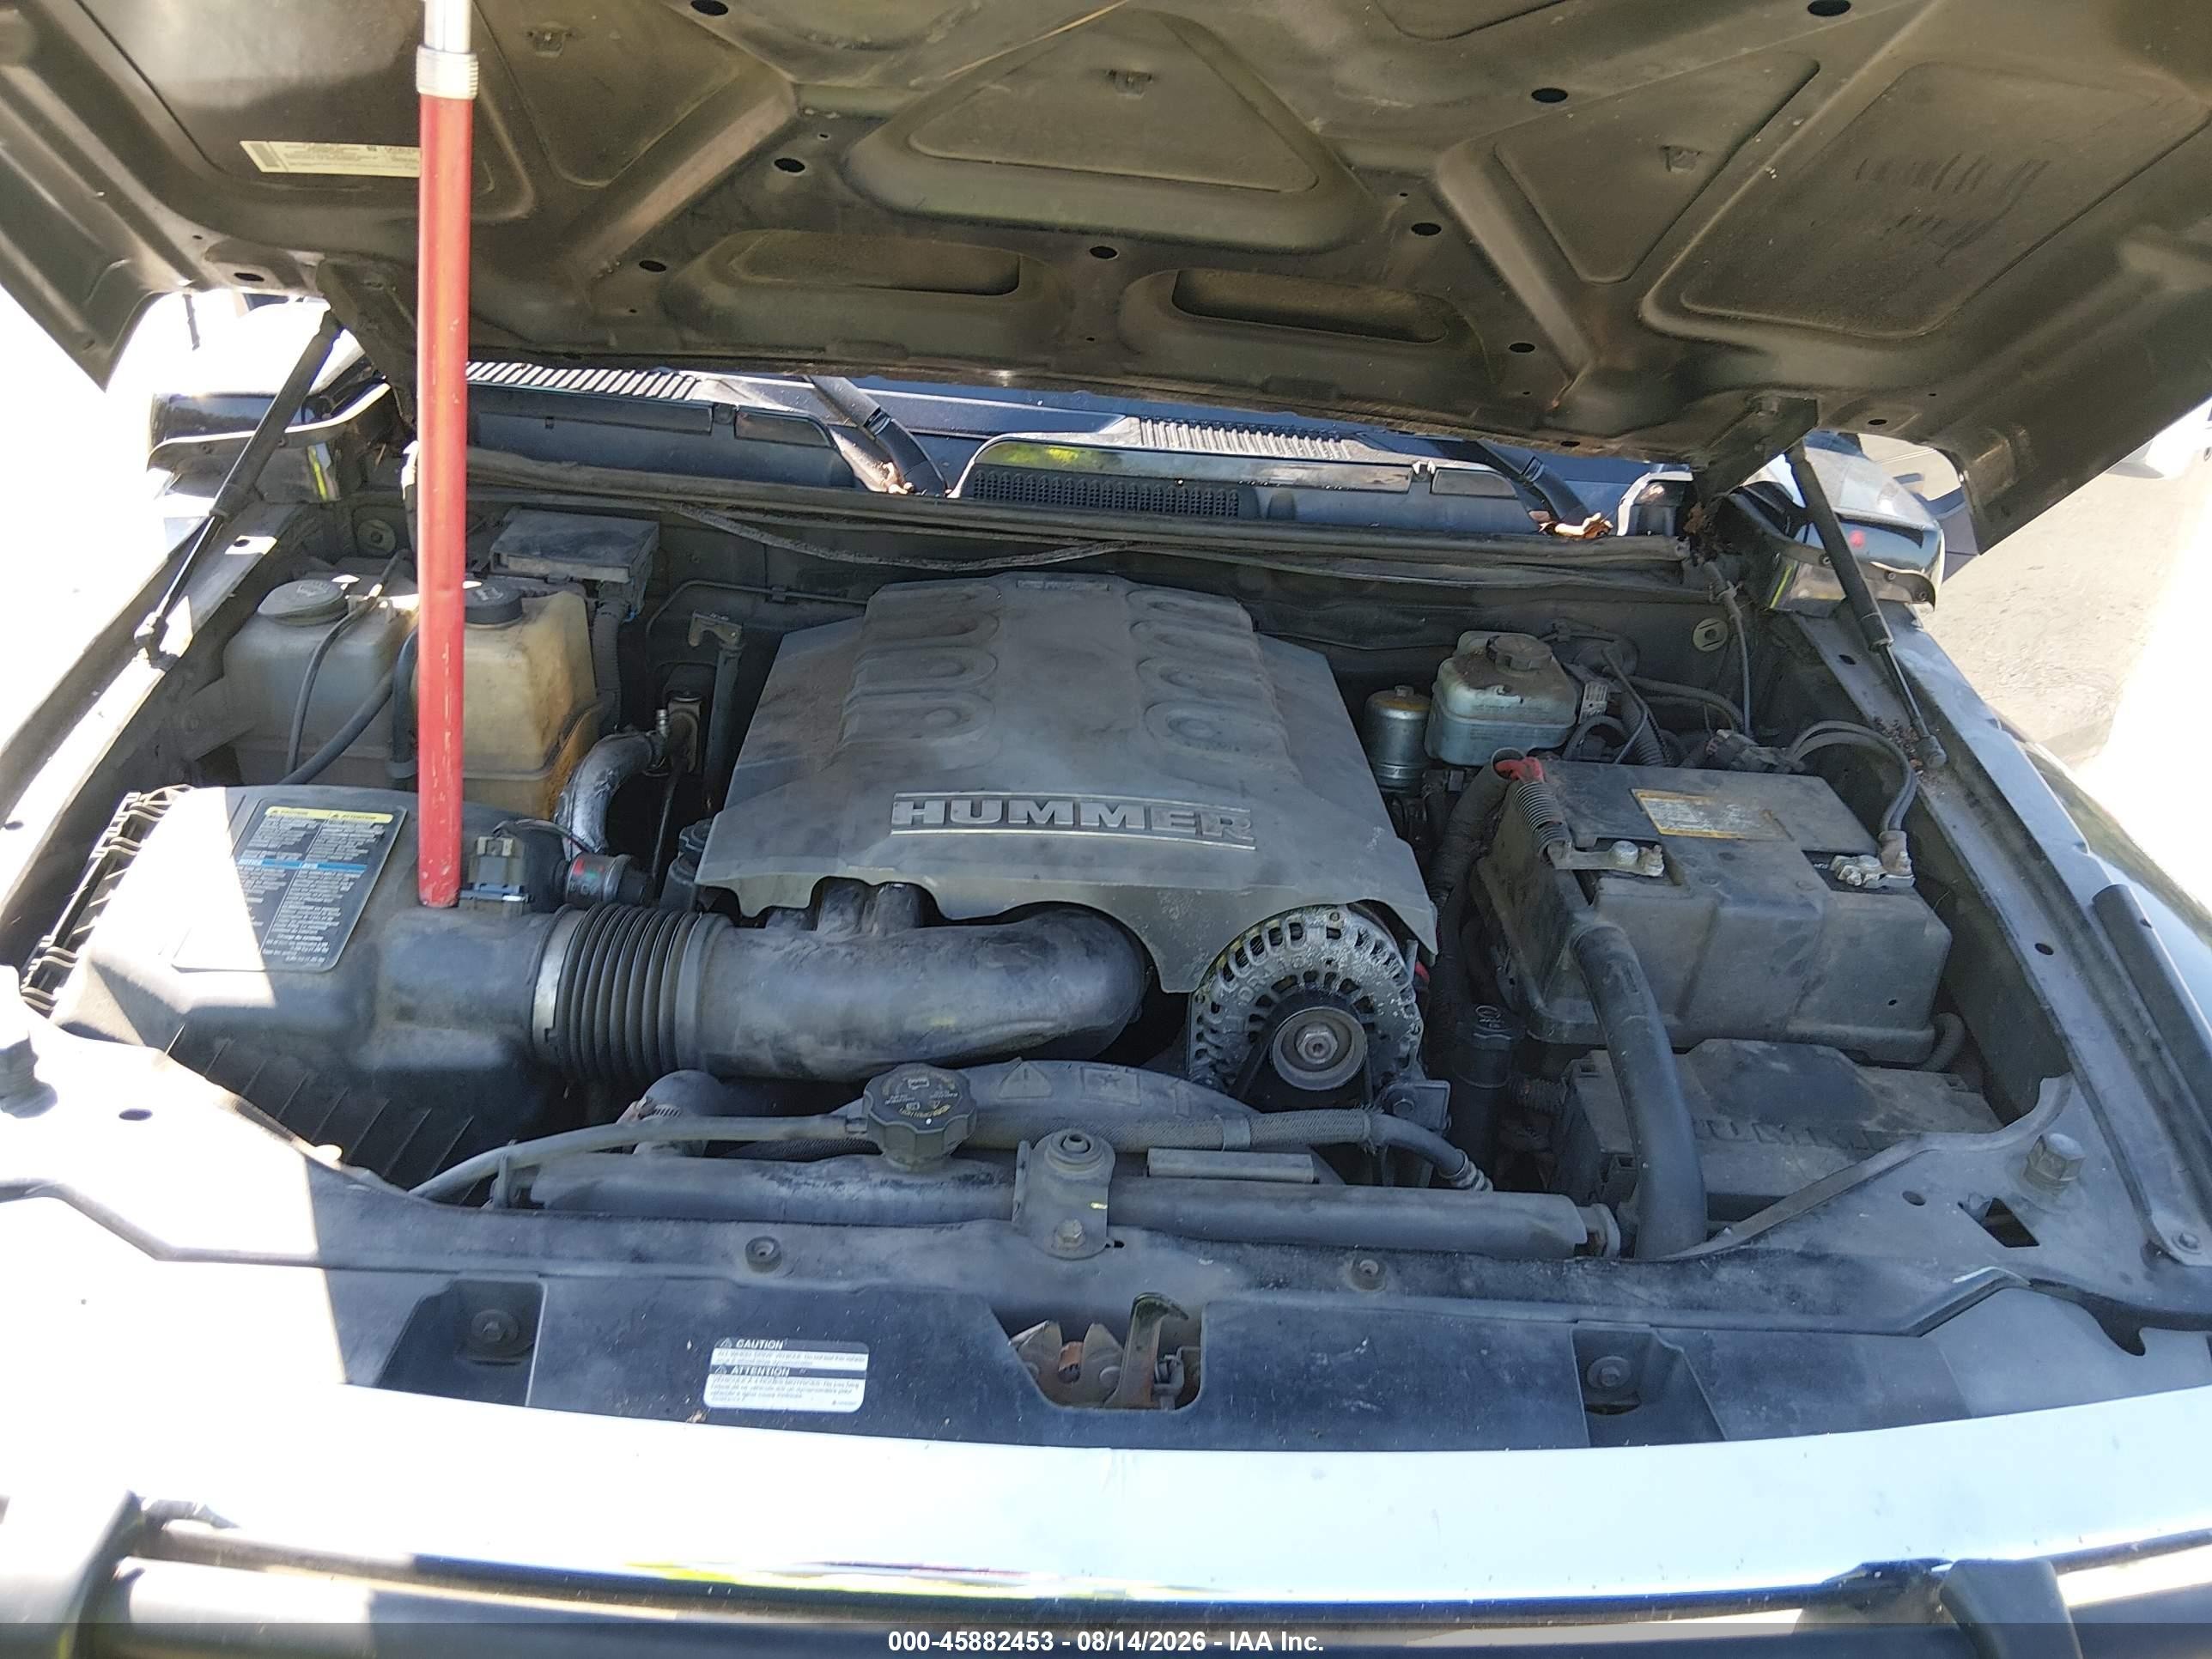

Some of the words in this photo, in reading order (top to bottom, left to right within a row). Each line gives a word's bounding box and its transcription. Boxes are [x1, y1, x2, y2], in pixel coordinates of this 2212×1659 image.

[891, 799, 1256, 841] HUMMER
[736, 1339, 784, 1350] CAUTION
[730, 1365, 790, 1377] ATTENTION
